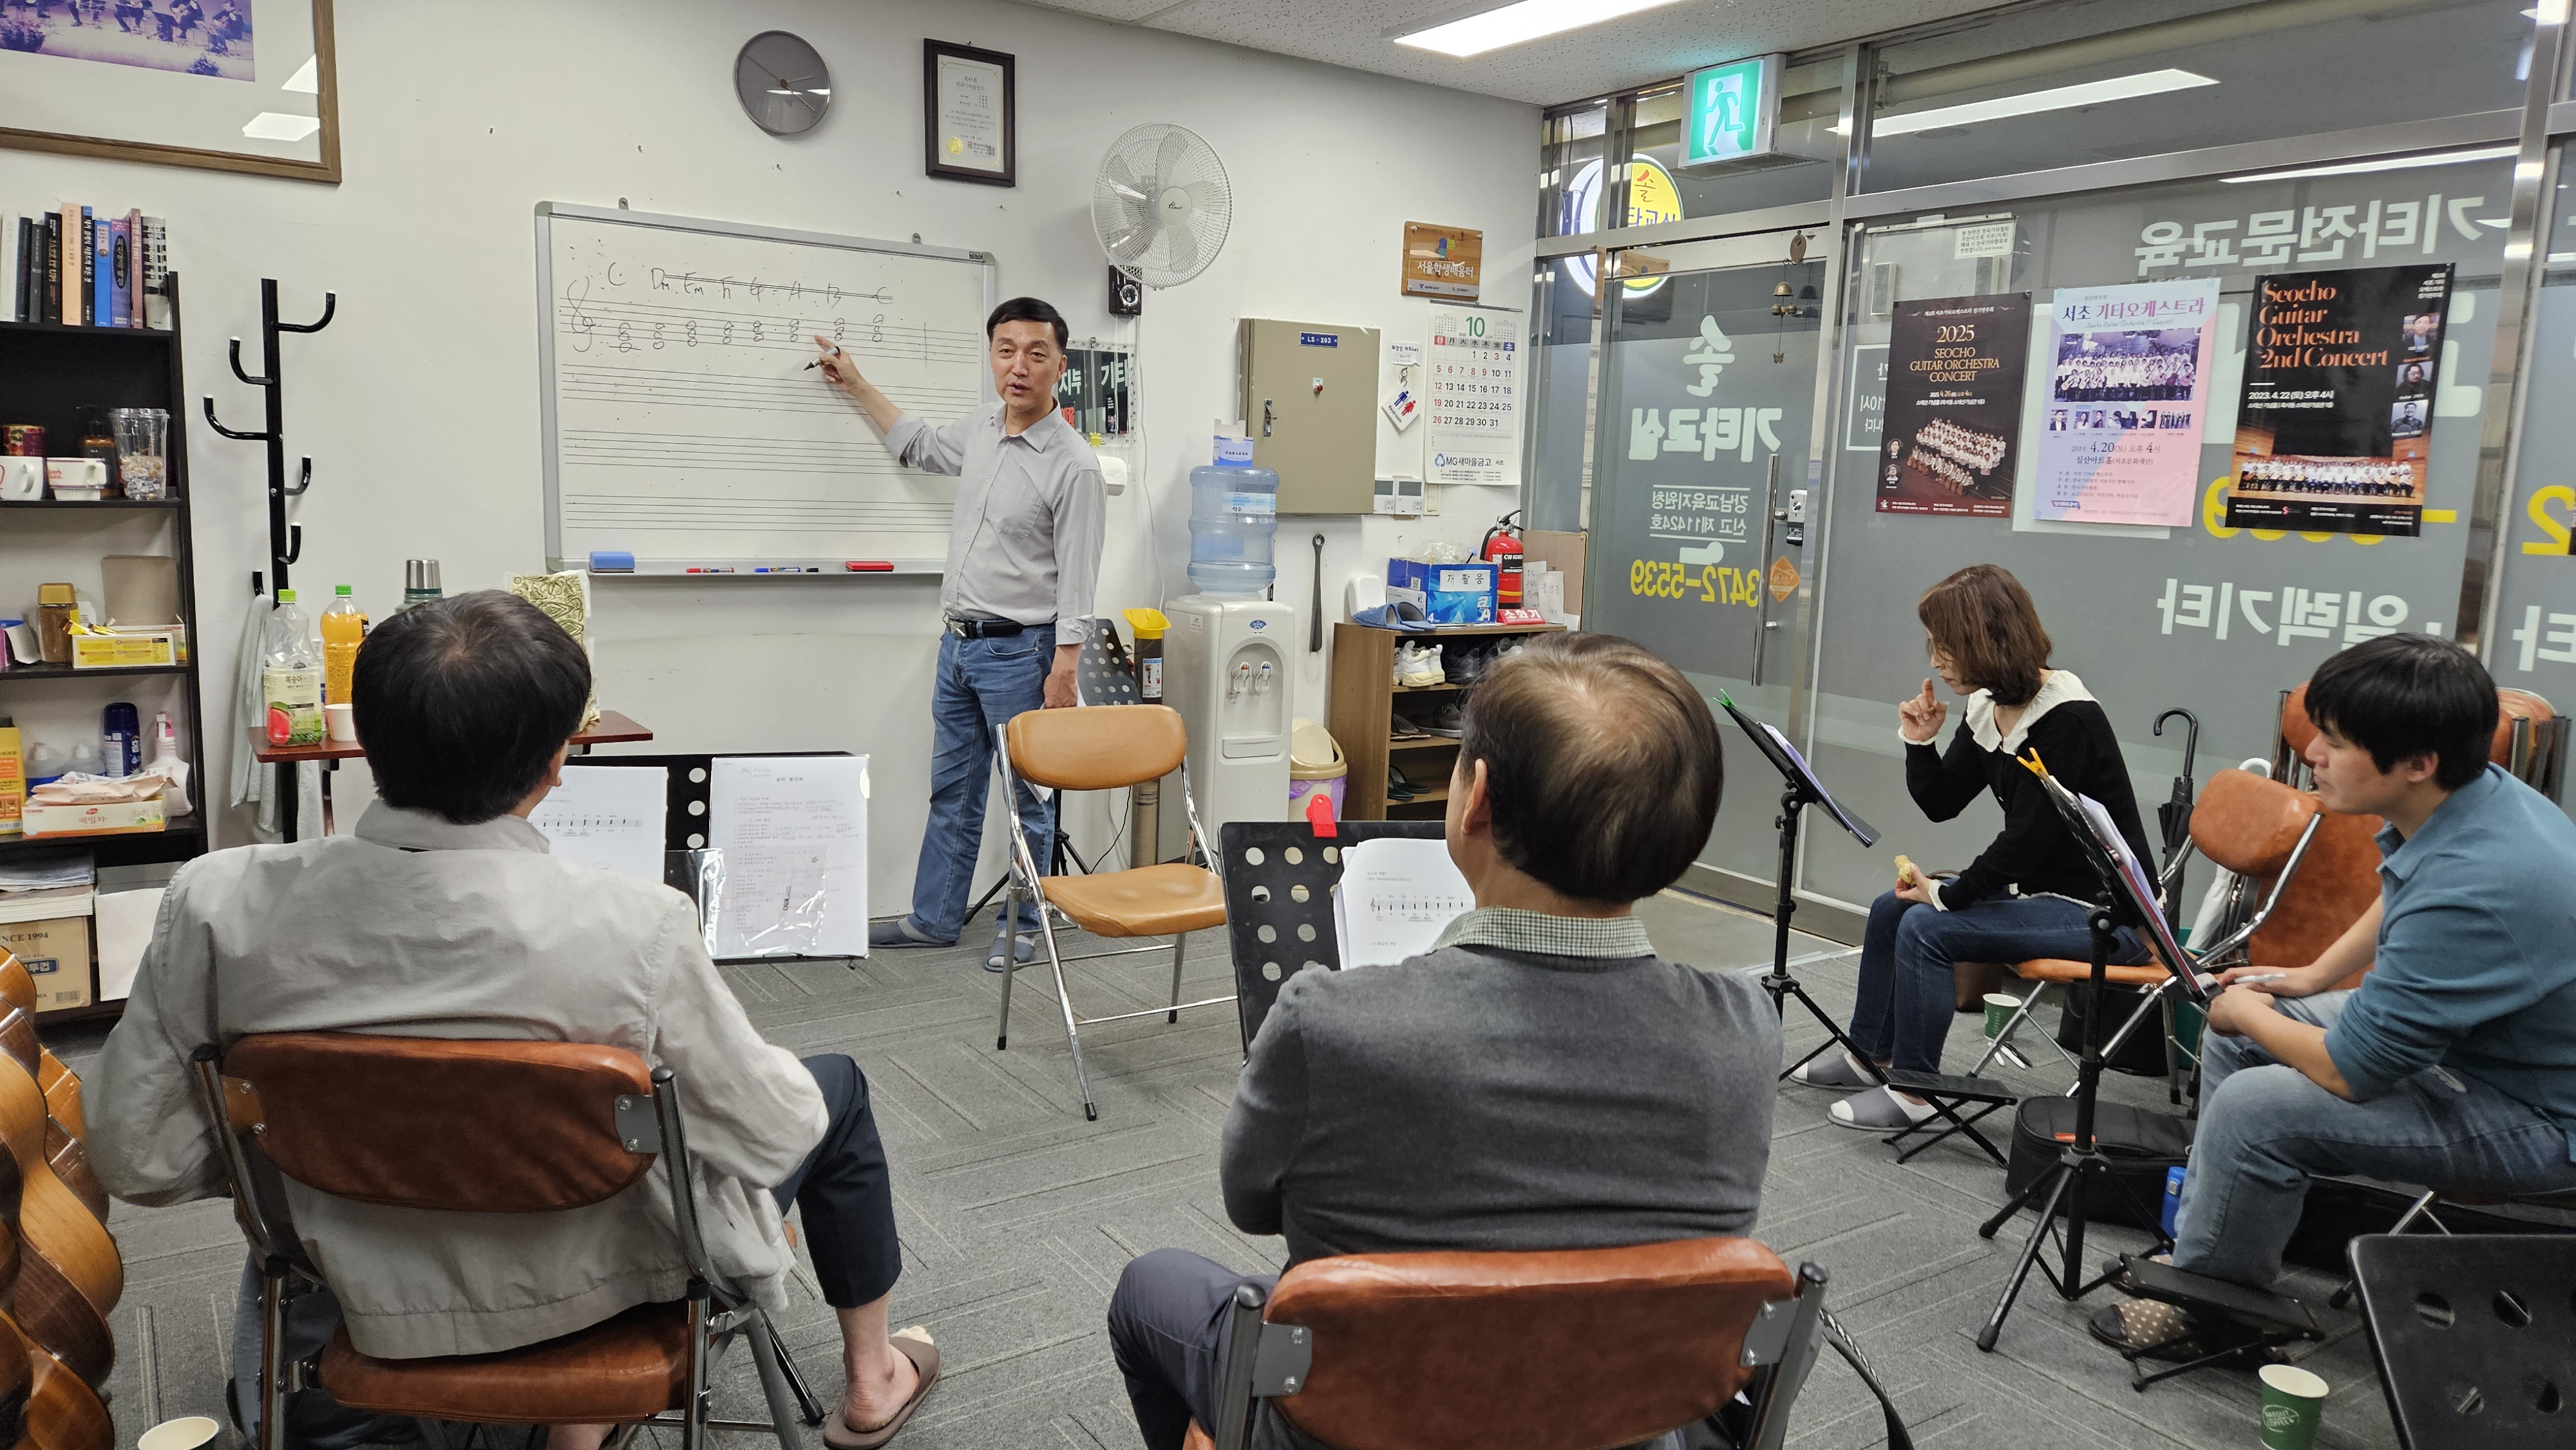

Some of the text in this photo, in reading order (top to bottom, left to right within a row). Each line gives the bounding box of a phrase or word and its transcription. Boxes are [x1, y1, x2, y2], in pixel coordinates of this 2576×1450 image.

[1634, 169, 1656, 202] 솔
[48, 238, 57, 258] JAZZ
[48, 258, 57, 268] IT
[1417, 260, 1473, 278] 서울학생배움터
[48, 268, 57, 282] UP!
[608, 262, 627, 285] C
[2264, 279, 2337, 303] Seocho
[2061, 297, 2205, 321] 서초 기타오케스트라
[2259, 303, 2329, 325] Guitar
[1465, 316, 1485, 337] 10
[1936, 324, 1975, 343] 2025
[2256, 325, 2360, 346] Orchestra
[1934, 346, 1976, 359] SEOCHO
[2259, 346, 2389, 368] 2nd Concert
[1909, 358, 2000, 371] GUITAR ORCHESTRA
[1929, 370, 1978, 382] CONCERT
[1468, 384, 1476, 393] 15
[1479, 385, 1488, 393] 16
[2304, 390, 2320, 399] 오후
[2320, 390, 2334, 399] 4시
[1478, 402, 1487, 410] 23
[1502, 403, 1511, 411] 25
[1388, 404, 1403, 424] Restroom
[1454, 417, 1463, 426] 28
[1477, 419, 1486, 427] 30
[2146, 442, 2161, 453] 4시
[1446, 457, 1492, 467] MG새마을금고
[1504, 609, 1541, 619] 소화기
[28, 932, 48, 941] 1994
